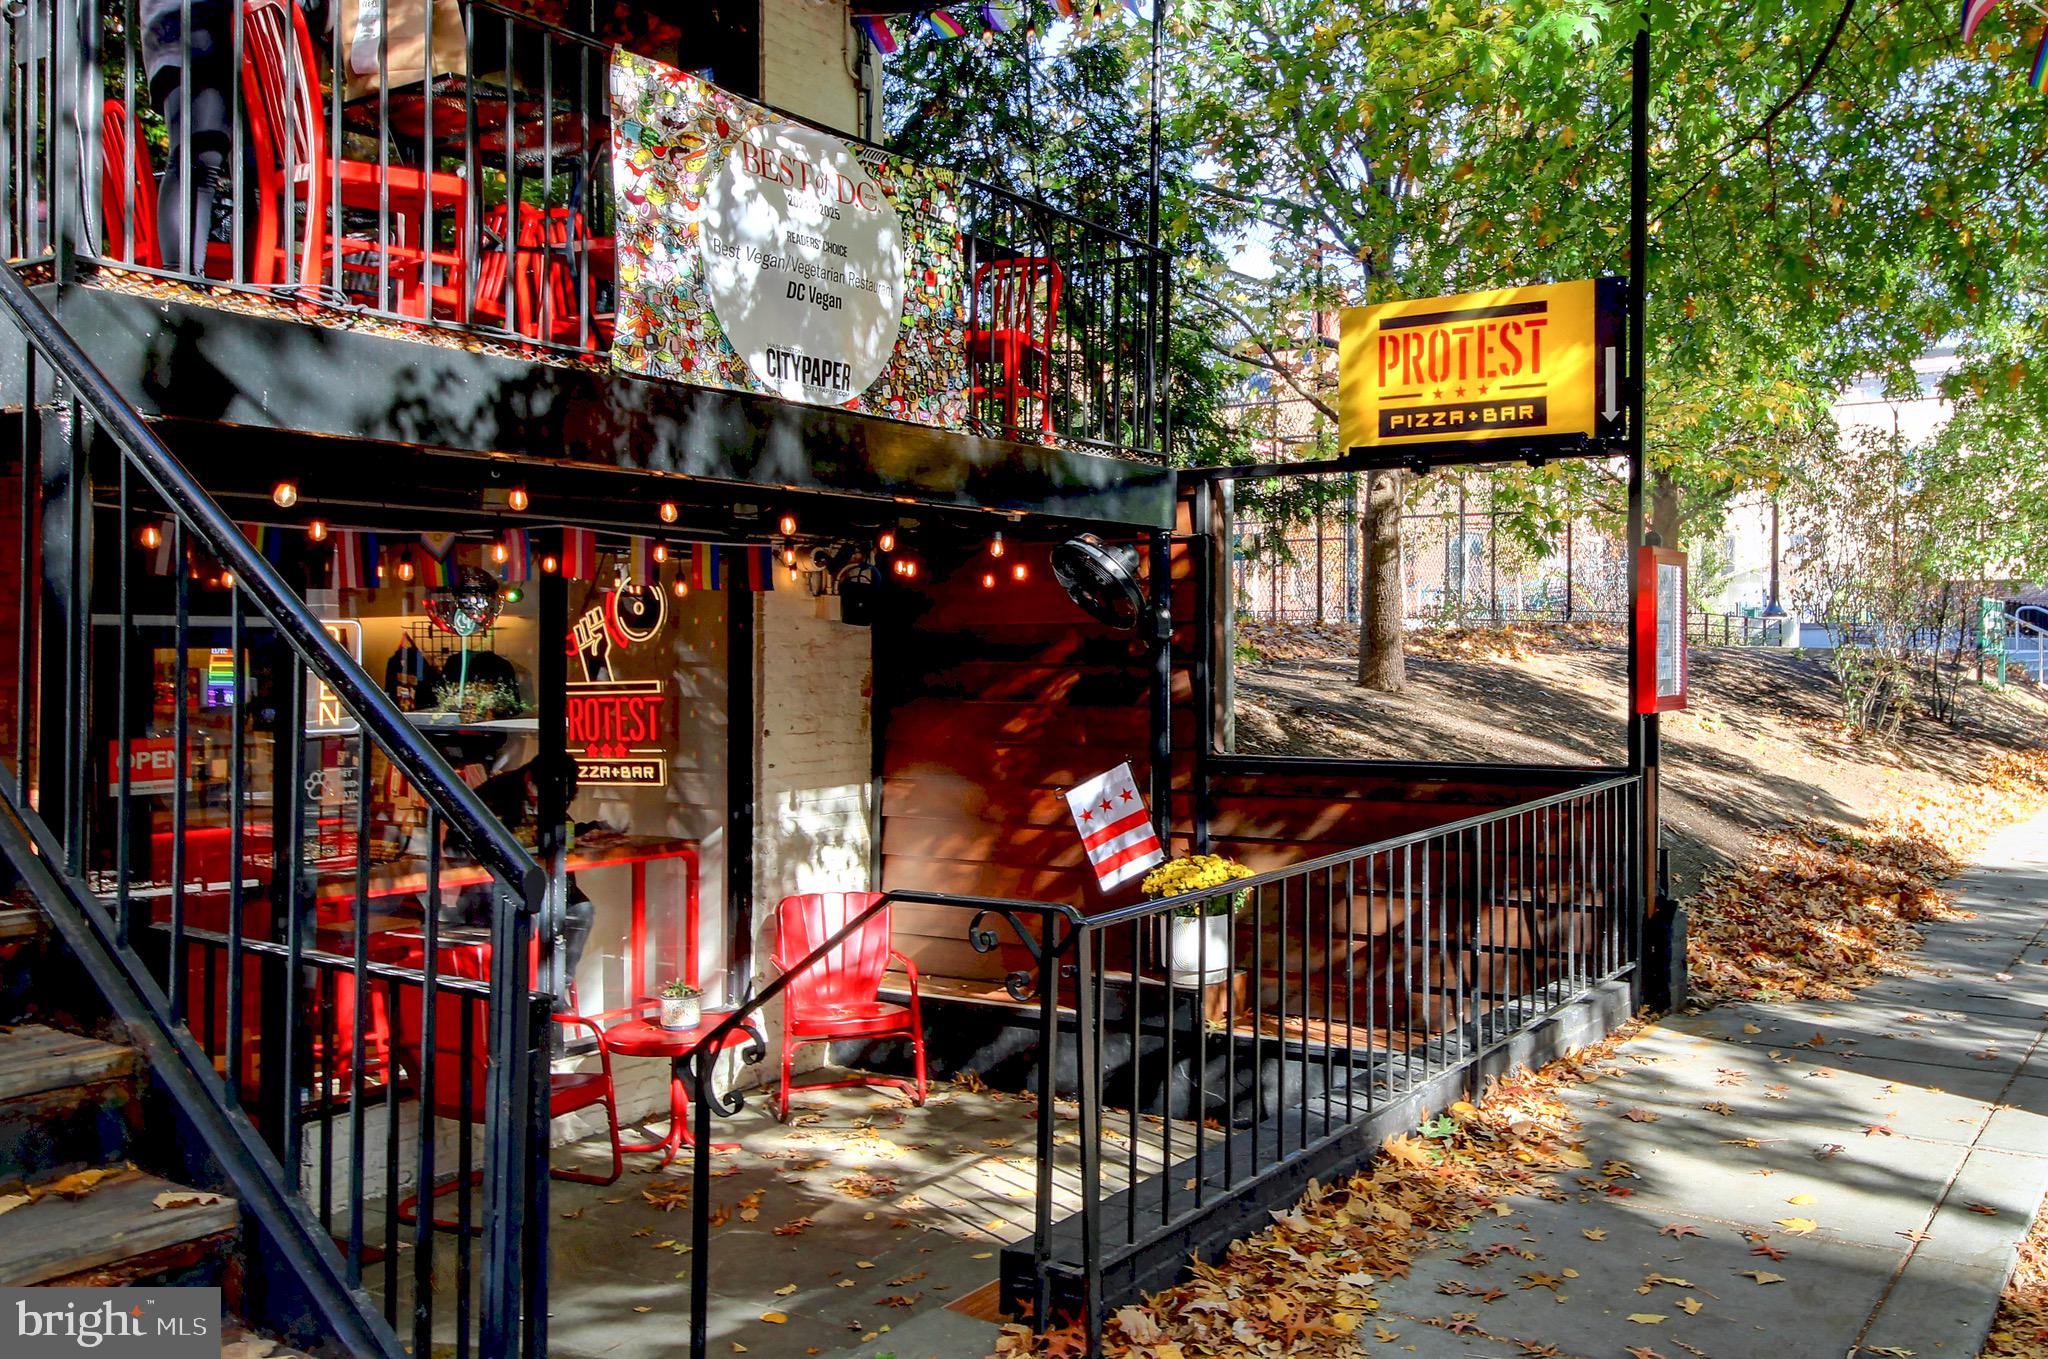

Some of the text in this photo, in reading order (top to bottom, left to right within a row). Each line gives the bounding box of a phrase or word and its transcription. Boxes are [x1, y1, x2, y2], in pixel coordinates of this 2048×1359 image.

[739, 138, 813, 192] BEST
[815, 174, 830, 196] of
[819, 203, 841, 220] 2025
[713, 237, 894, 298] Best Vegan/Vegetarian Restaurant
[822, 241, 848, 258] CHOICE
[786, 280, 842, 311] DC Vegan
[766, 348, 852, 391] CITYPAPER
[1378, 318, 1548, 388] PROTEST
[567, 697, 665, 742] ROTEST
[577, 765, 655, 780] ZZA+BAR
